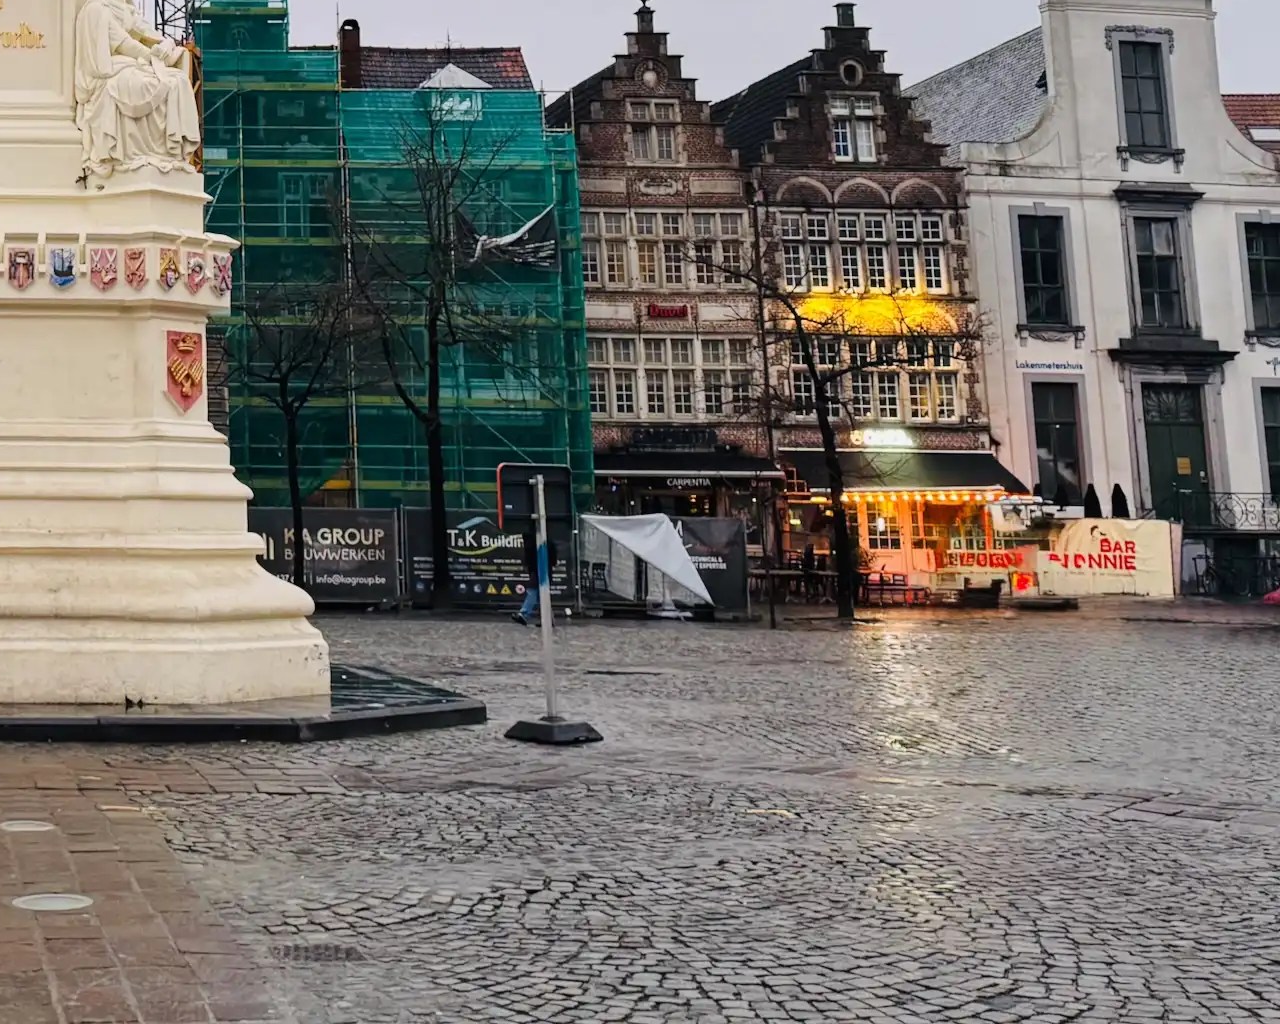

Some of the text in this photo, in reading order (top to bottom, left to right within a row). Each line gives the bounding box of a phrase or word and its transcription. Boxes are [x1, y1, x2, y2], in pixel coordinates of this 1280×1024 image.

[666, 478, 712, 487] CARPENTIA
[316, 527, 385, 545] GROUP
[446, 529, 525, 549] T&K Buildin
[1100, 538, 1136, 554] BAR
[284, 548, 386, 561] BUWWERKEN
